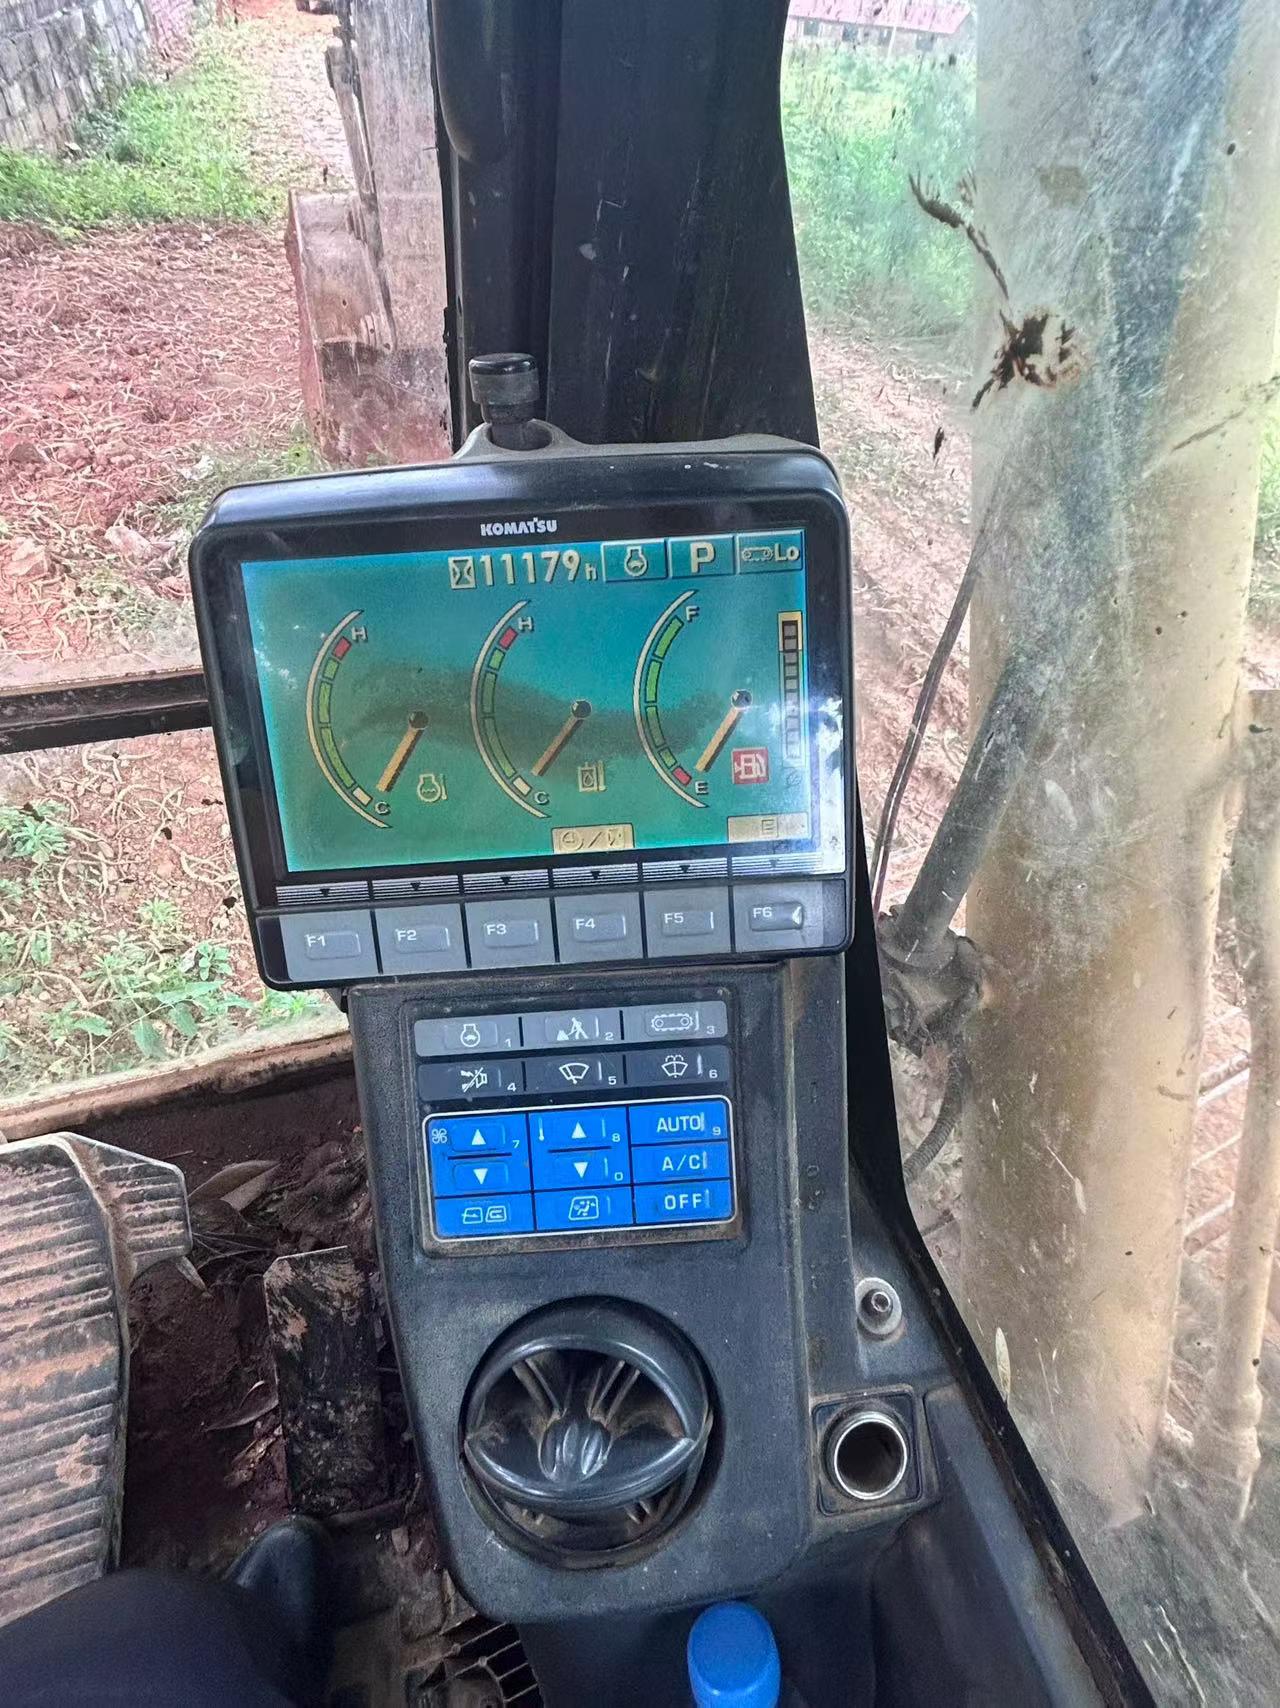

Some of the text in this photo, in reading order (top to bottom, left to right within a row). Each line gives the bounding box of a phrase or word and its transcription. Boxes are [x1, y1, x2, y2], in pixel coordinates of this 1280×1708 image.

[480, 518, 557, 537] KOMATSU
[690, 542, 715, 573] P
[775, 543, 800, 562] Lo
[685, 605, 699, 621] F
[517, 617, 534, 632] H
[351, 626, 368, 642] H
[695, 781, 709, 795] E
[534, 790, 550, 805] C
[374, 801, 391, 816] C
[664, 912, 684, 924] F5
[753, 907, 773, 919] F6
[486, 923, 507, 935] F3
[575, 918, 595, 930] F4
[307, 935, 326, 947] F1
[397, 929, 417, 941] F2
[604, 1031, 614, 1041] 2
[706, 1025, 715, 1035] 3
[504, 1038, 512, 1048] 1
[709, 1069, 718, 1079] 6
[507, 1082, 516, 1092] 4
[608, 1076, 617, 1086] 5
[656, 1115, 701, 1132] AUTO
[712, 1126, 721, 1136] 9
[611, 1133, 621, 1143] 8
[512, 1140, 520, 1149] 7
[661, 1154, 701, 1172] A/C
[664, 1193, 702, 1210] OFF
